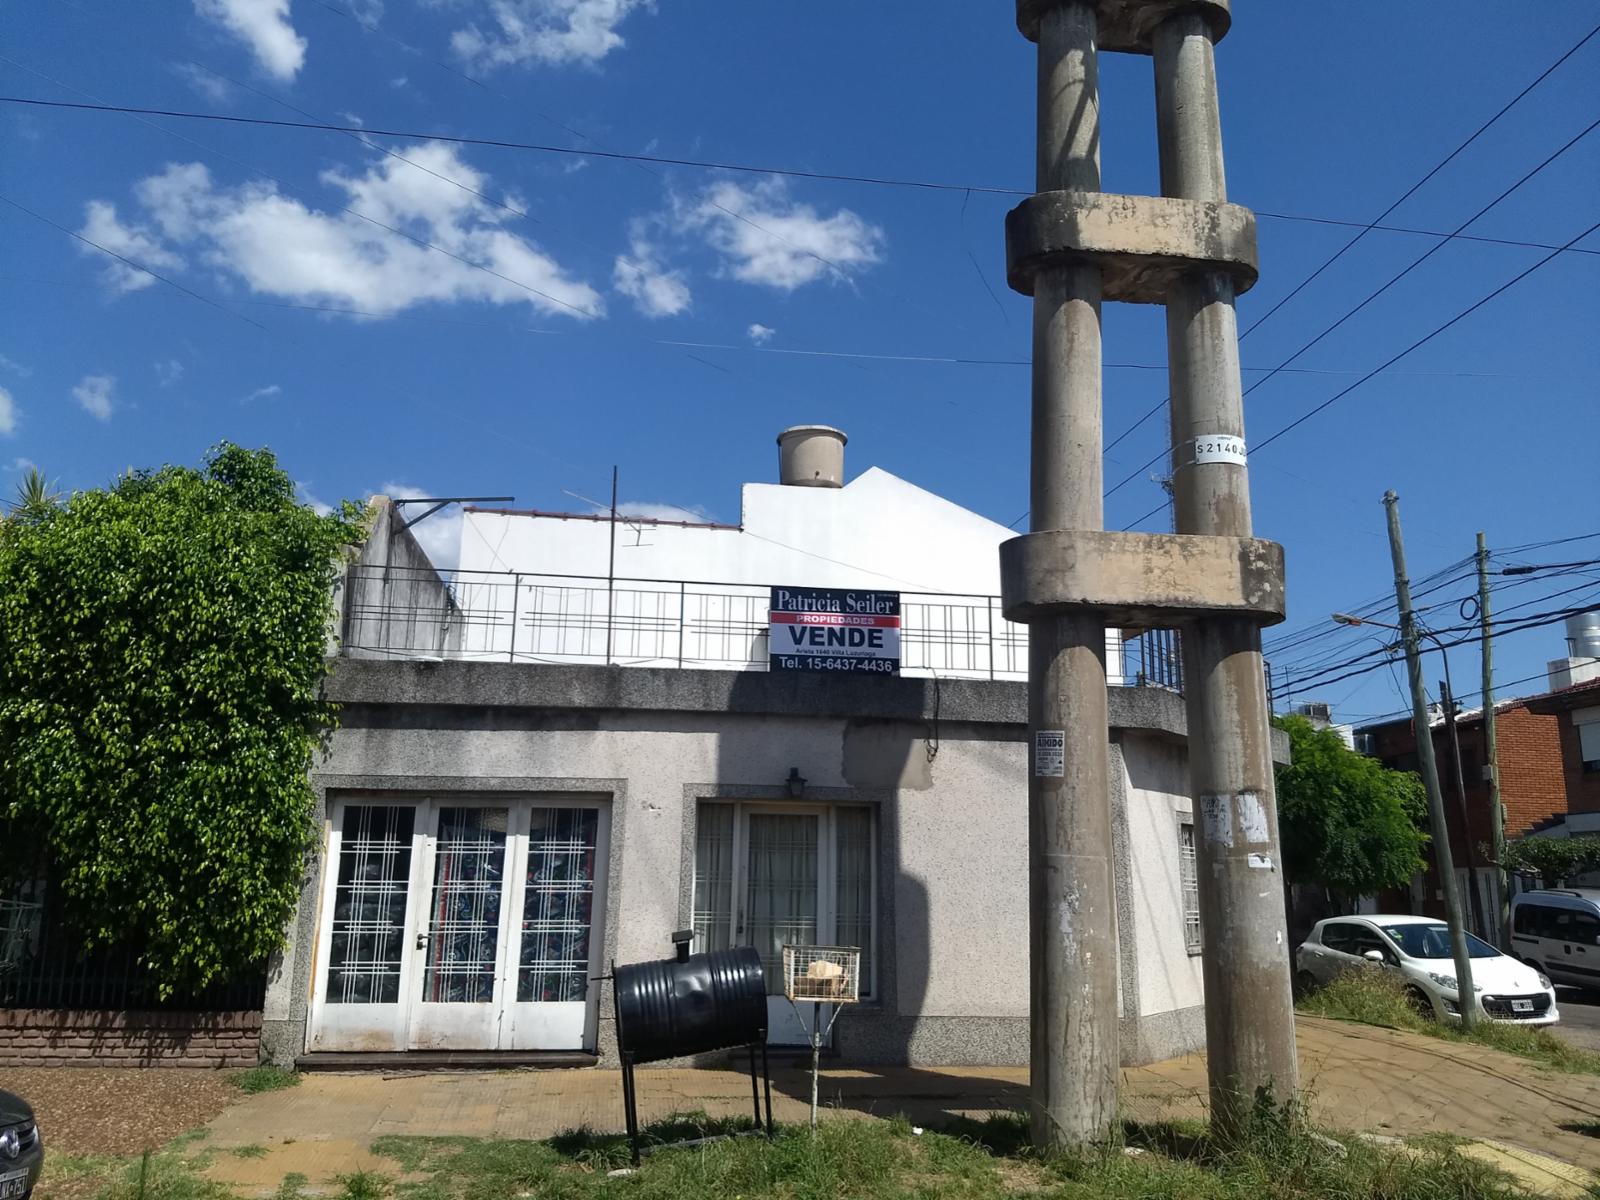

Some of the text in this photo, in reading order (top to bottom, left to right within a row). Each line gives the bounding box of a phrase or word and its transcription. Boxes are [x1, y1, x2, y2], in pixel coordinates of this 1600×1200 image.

[778, 590, 893, 614] Patricia Seiler
[796, 615, 875, 625] PROPIEDADES
[788, 625, 884, 649] VENDE
[779, 656, 893, 672] Tel. 15-6437-4436
